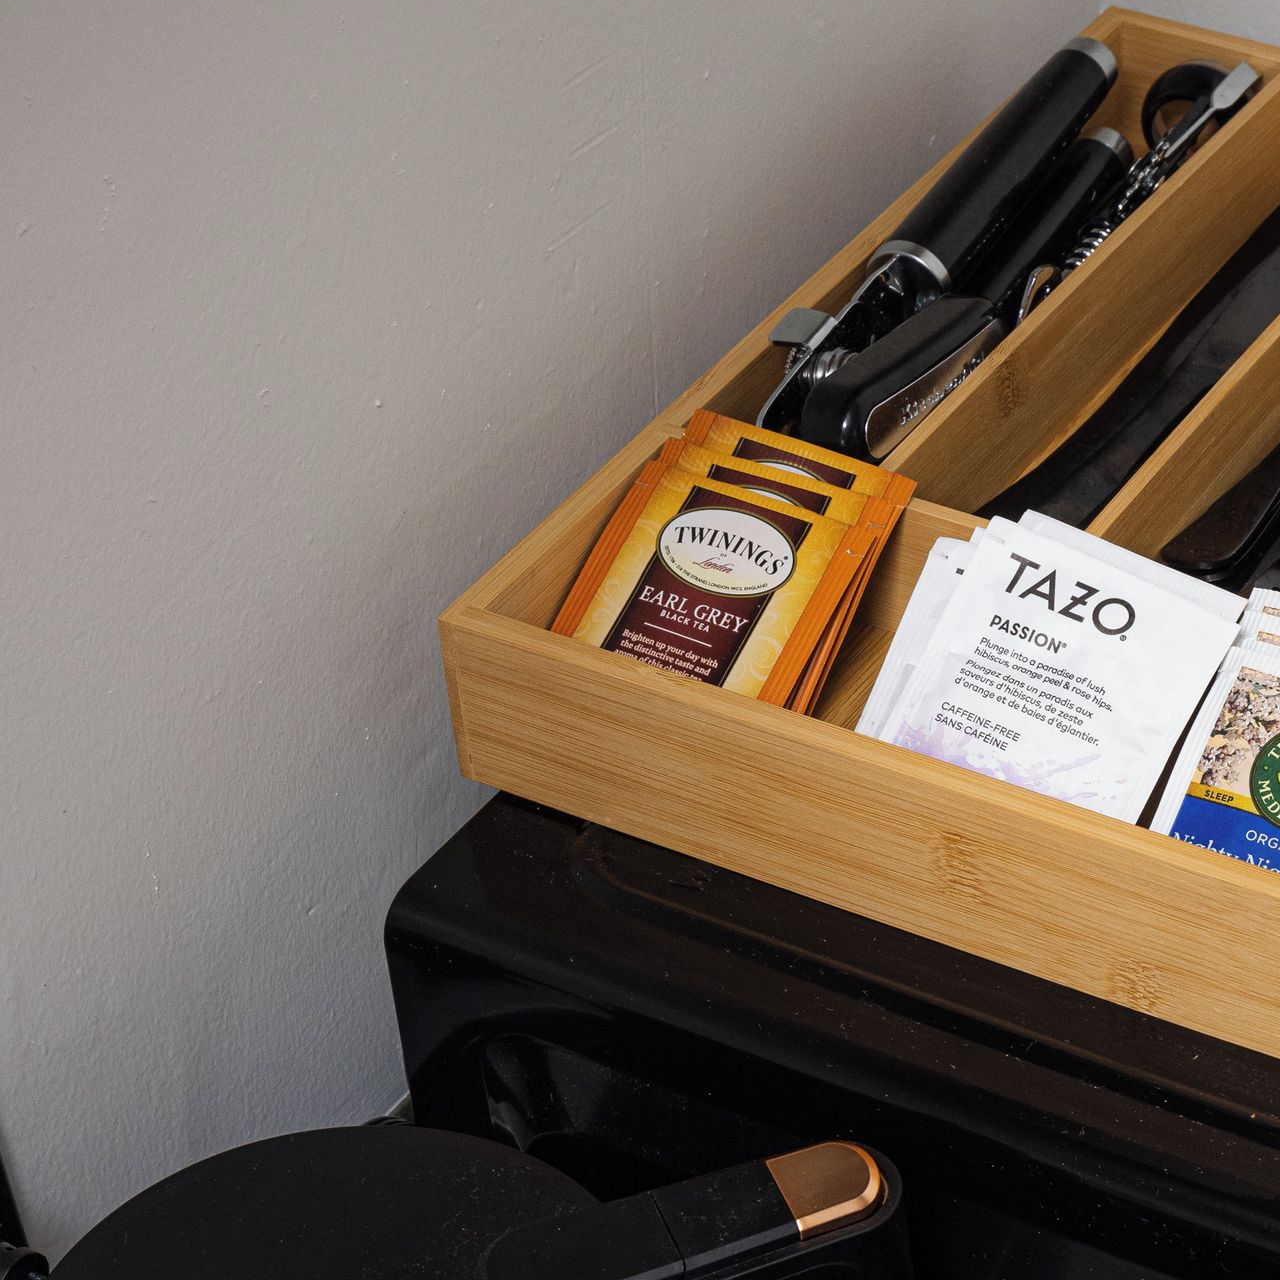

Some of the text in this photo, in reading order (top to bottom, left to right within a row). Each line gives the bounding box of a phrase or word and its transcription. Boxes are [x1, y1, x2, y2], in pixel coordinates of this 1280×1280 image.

[692, 556, 735, 574] London
[707, 582, 730, 591] LONDON
[743, 582, 768, 591] ENGLAND
[639, 585, 749, 633] EARL GREY
[660, 609, 710, 633] BLACK TEA
[613, 649, 638, 661] aroma
[638, 655, 649, 664] of
[648, 657, 663, 669] this
[620, 639, 711, 676] the distinctive taste and
[622, 629, 718, 669] Brighten up your day with
[980, 637, 1009, 656] Plunge
[1010, 649, 1028, 663] into
[1036, 662, 1075, 680] paradise
[1075, 675, 1088, 686] of
[1087, 680, 1106, 695] lush
[959, 667, 1084, 726] saveurs d'hibiscus, de zeste
[965, 659, 1094, 719] Plongez dans un paradis aux
[974, 646, 1113, 712] hibiscus, orange peel & rose hips.
[934, 713, 1009, 751] SANS CAFÉINE
[941, 701, 1021, 742] CAFFEINE-FREE
[954, 677, 1099, 747] d'orange et de baies d'églantier.
[1204, 789, 1234, 804] SLEEP
